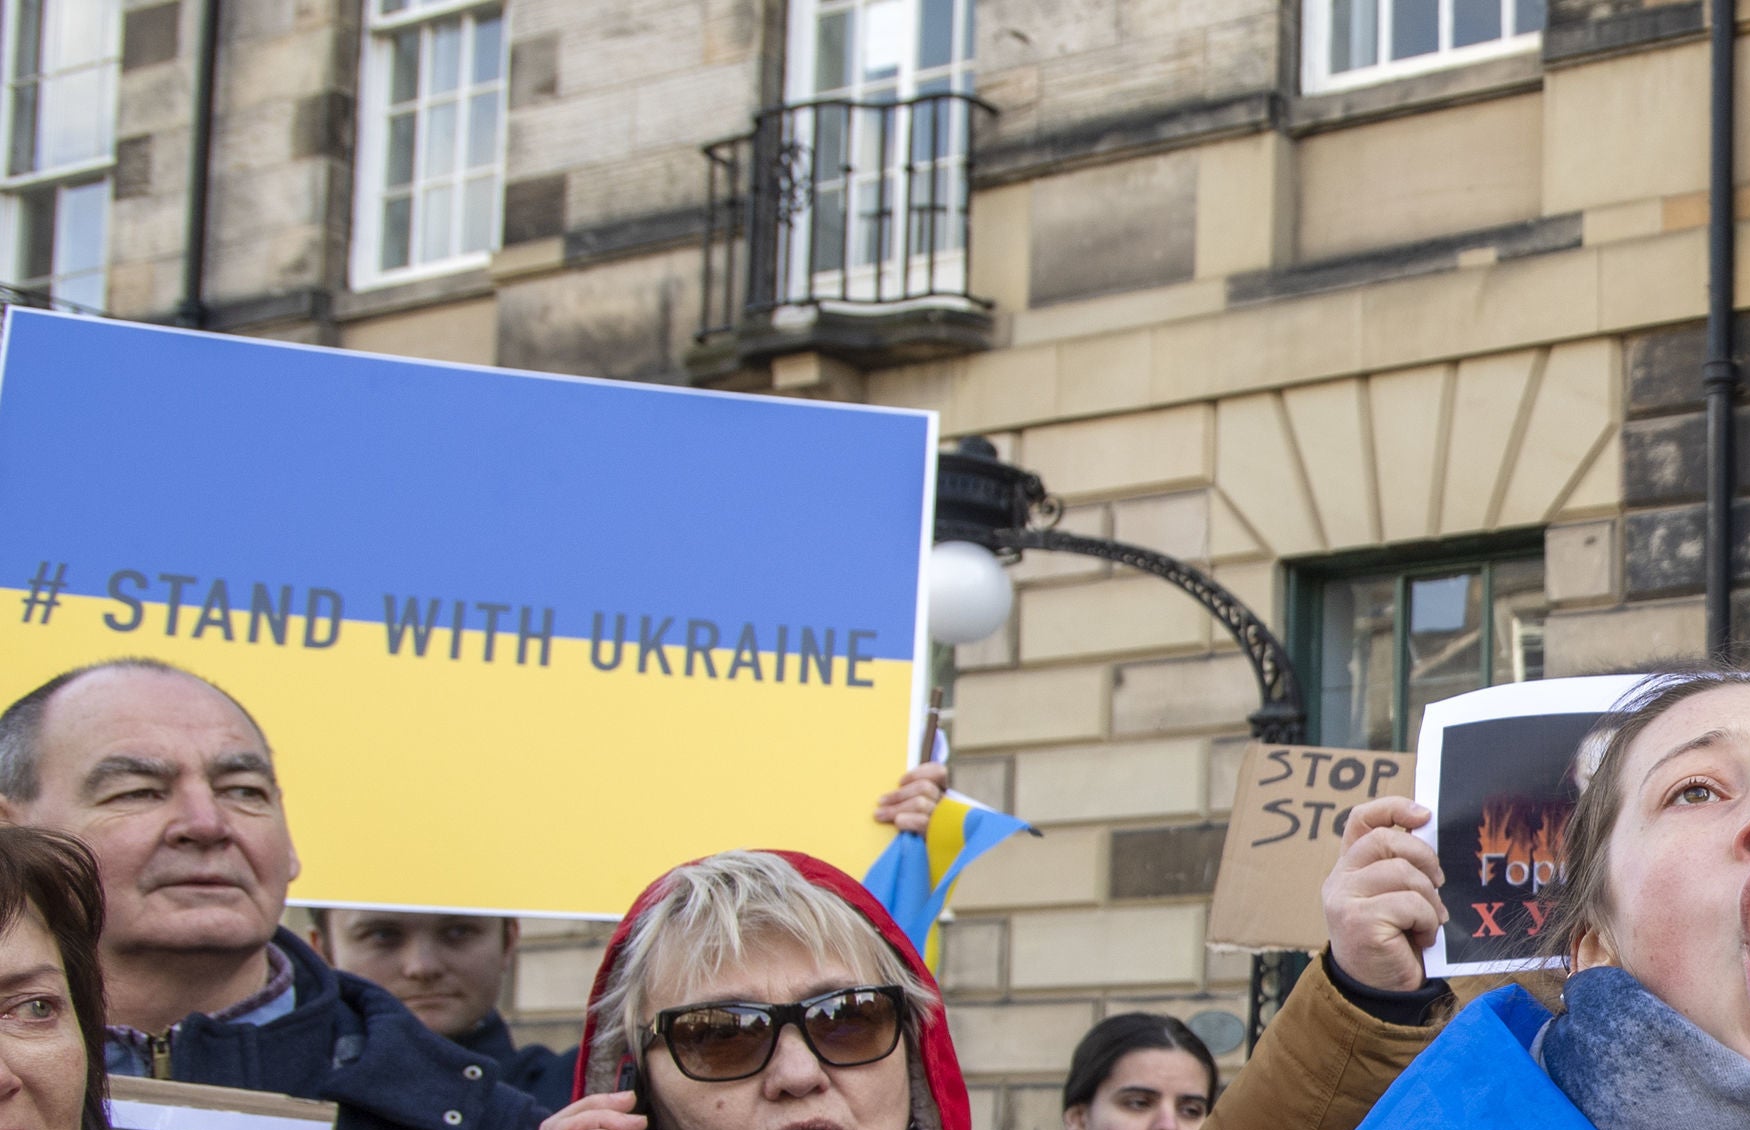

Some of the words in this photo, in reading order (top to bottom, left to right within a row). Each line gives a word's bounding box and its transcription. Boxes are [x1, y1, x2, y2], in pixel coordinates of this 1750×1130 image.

[22, 561, 68, 624] #
[102, 569, 344, 649] STAND
[384, 594, 554, 667] WITH
[590, 611, 878, 688] UKRAINE
[1259, 750, 1399, 797] STOP
